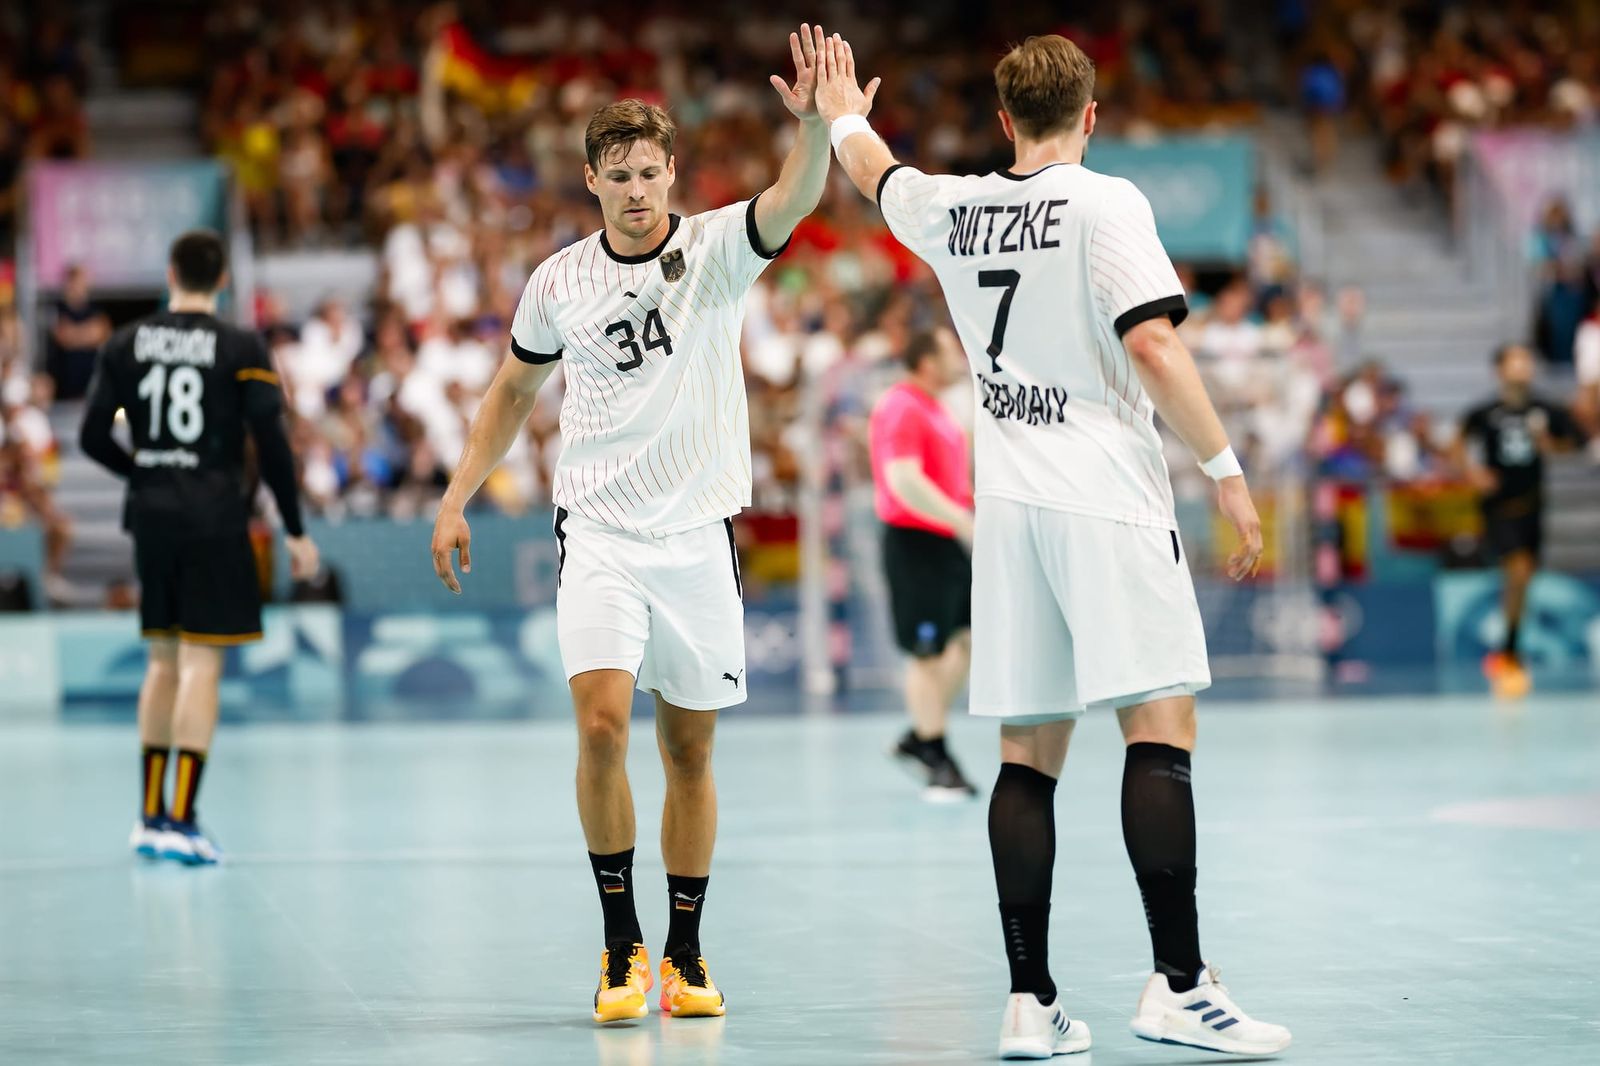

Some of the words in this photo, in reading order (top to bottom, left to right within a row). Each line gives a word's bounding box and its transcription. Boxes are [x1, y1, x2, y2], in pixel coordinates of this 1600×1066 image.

[948, 199, 1069, 256] WITZKE
[605, 308, 674, 372] 34
[977, 268, 1021, 373] 7
[138, 364, 204, 443] 18
